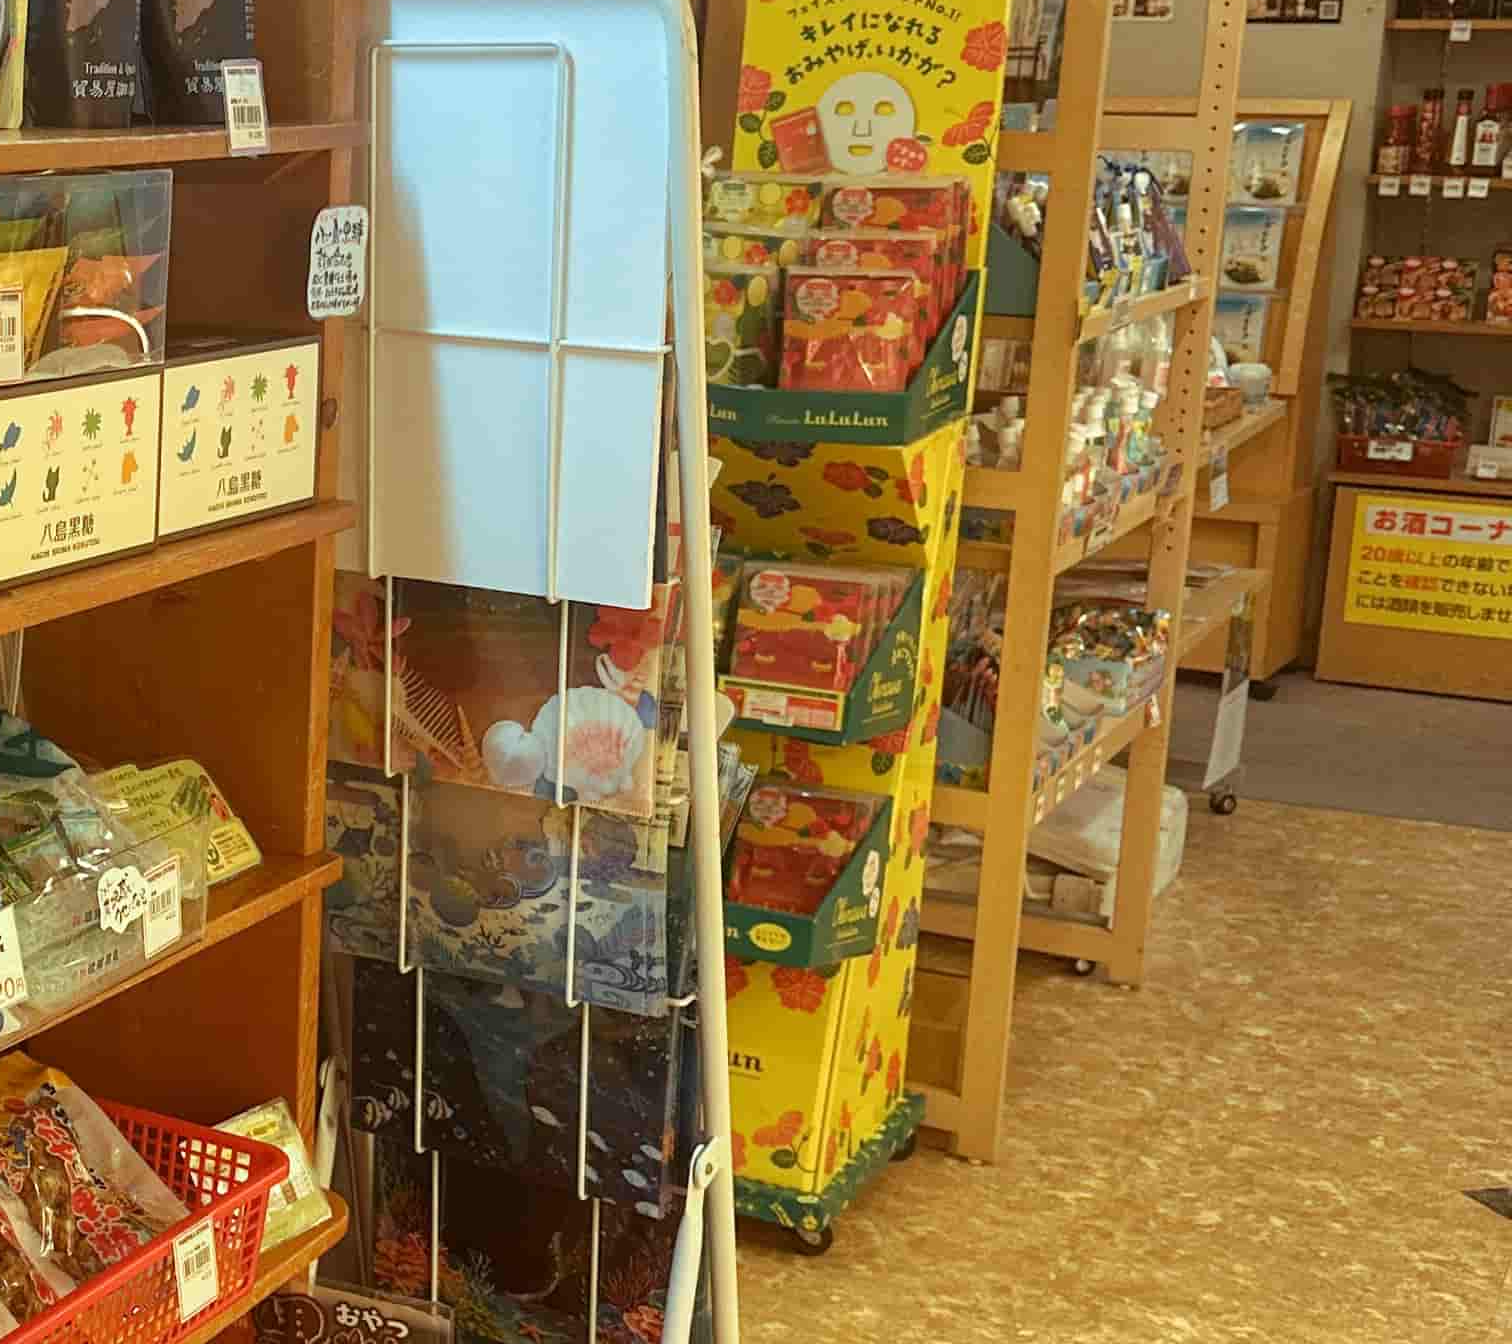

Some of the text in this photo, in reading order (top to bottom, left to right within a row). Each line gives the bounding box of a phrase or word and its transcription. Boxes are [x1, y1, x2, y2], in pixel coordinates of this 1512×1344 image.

[800, 10, 943, 45] キレイになれる
[803, 410, 889, 428] LuLuLun
[40, 512, 95, 546] 八島黒糖
[336, 1303, 410, 1338] おやつ
